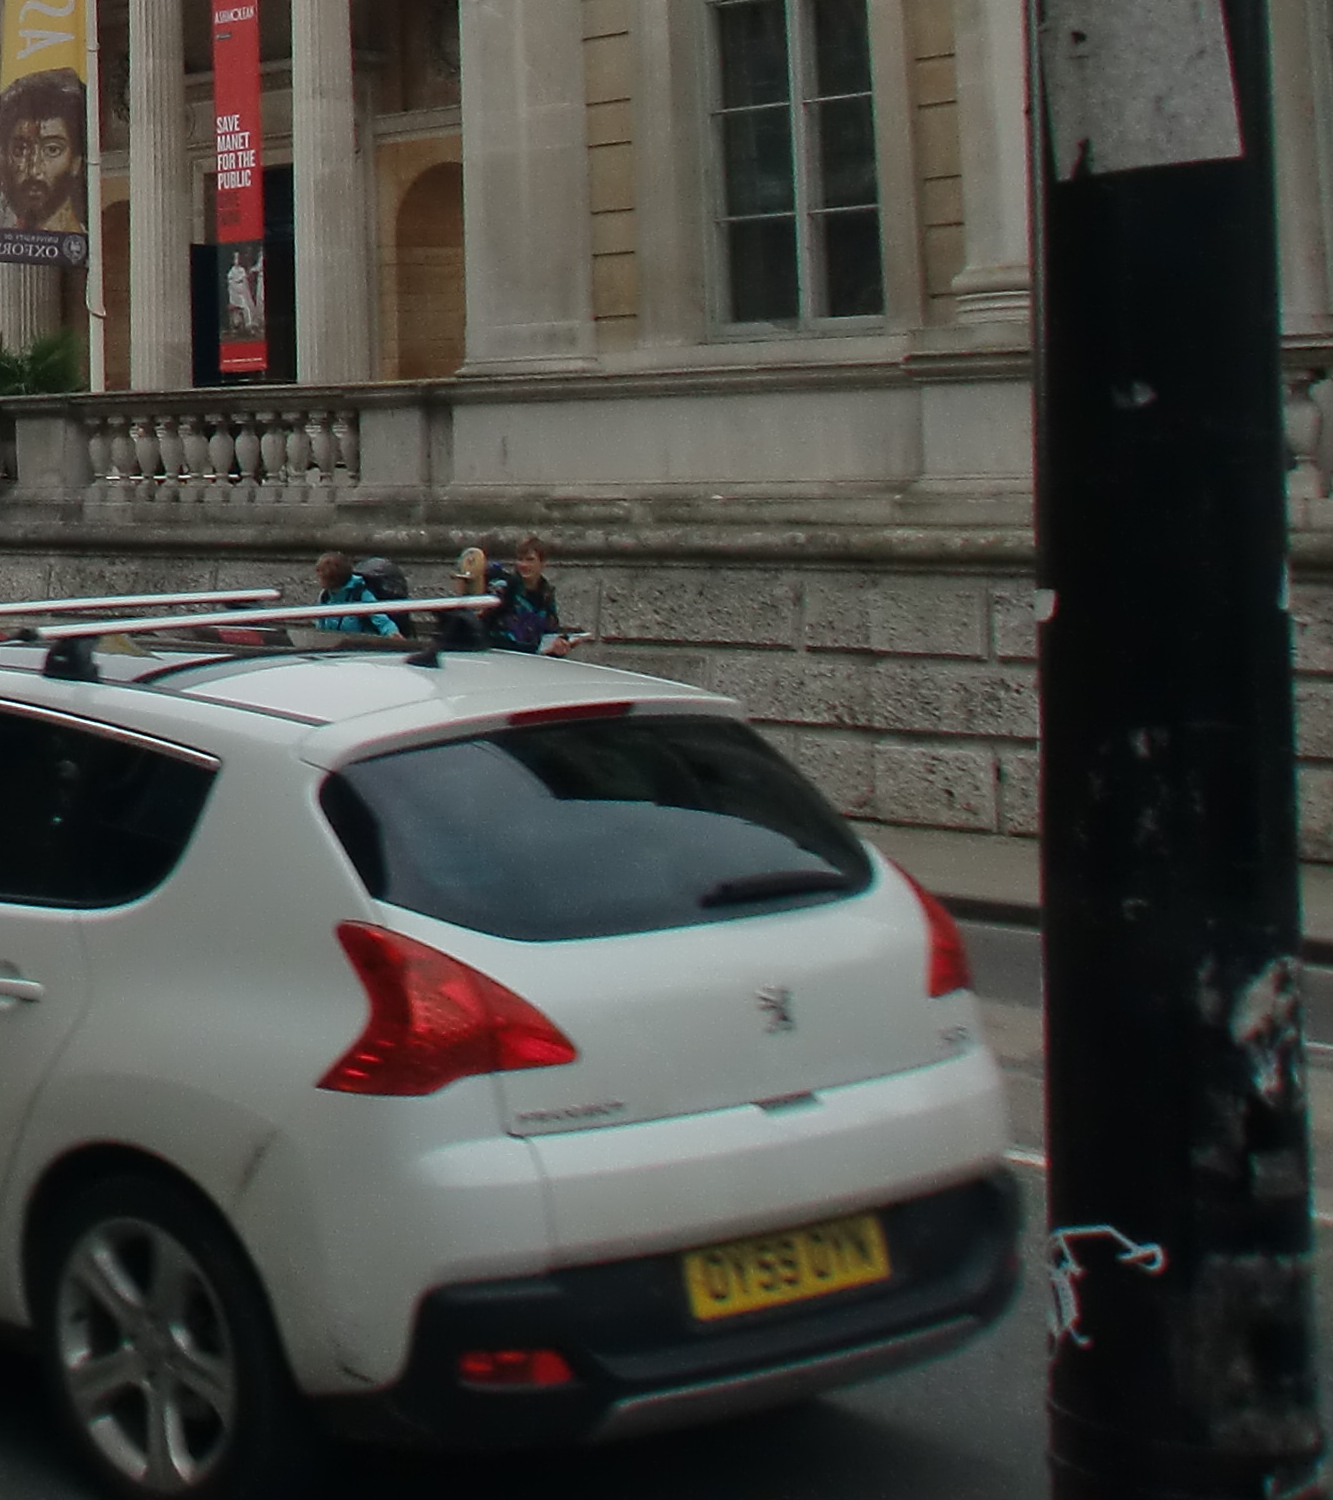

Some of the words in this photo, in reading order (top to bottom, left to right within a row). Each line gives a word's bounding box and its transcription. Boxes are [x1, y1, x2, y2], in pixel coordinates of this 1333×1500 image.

[214, 5, 255, 24] ASHMOLEAN
[216, 114, 240, 134] SAVE
[217, 131, 250, 151] MANET
[217, 152, 237, 171] FOR
[237, 149, 256, 168] THE
[217, 169, 252, 190] PUBLIC
